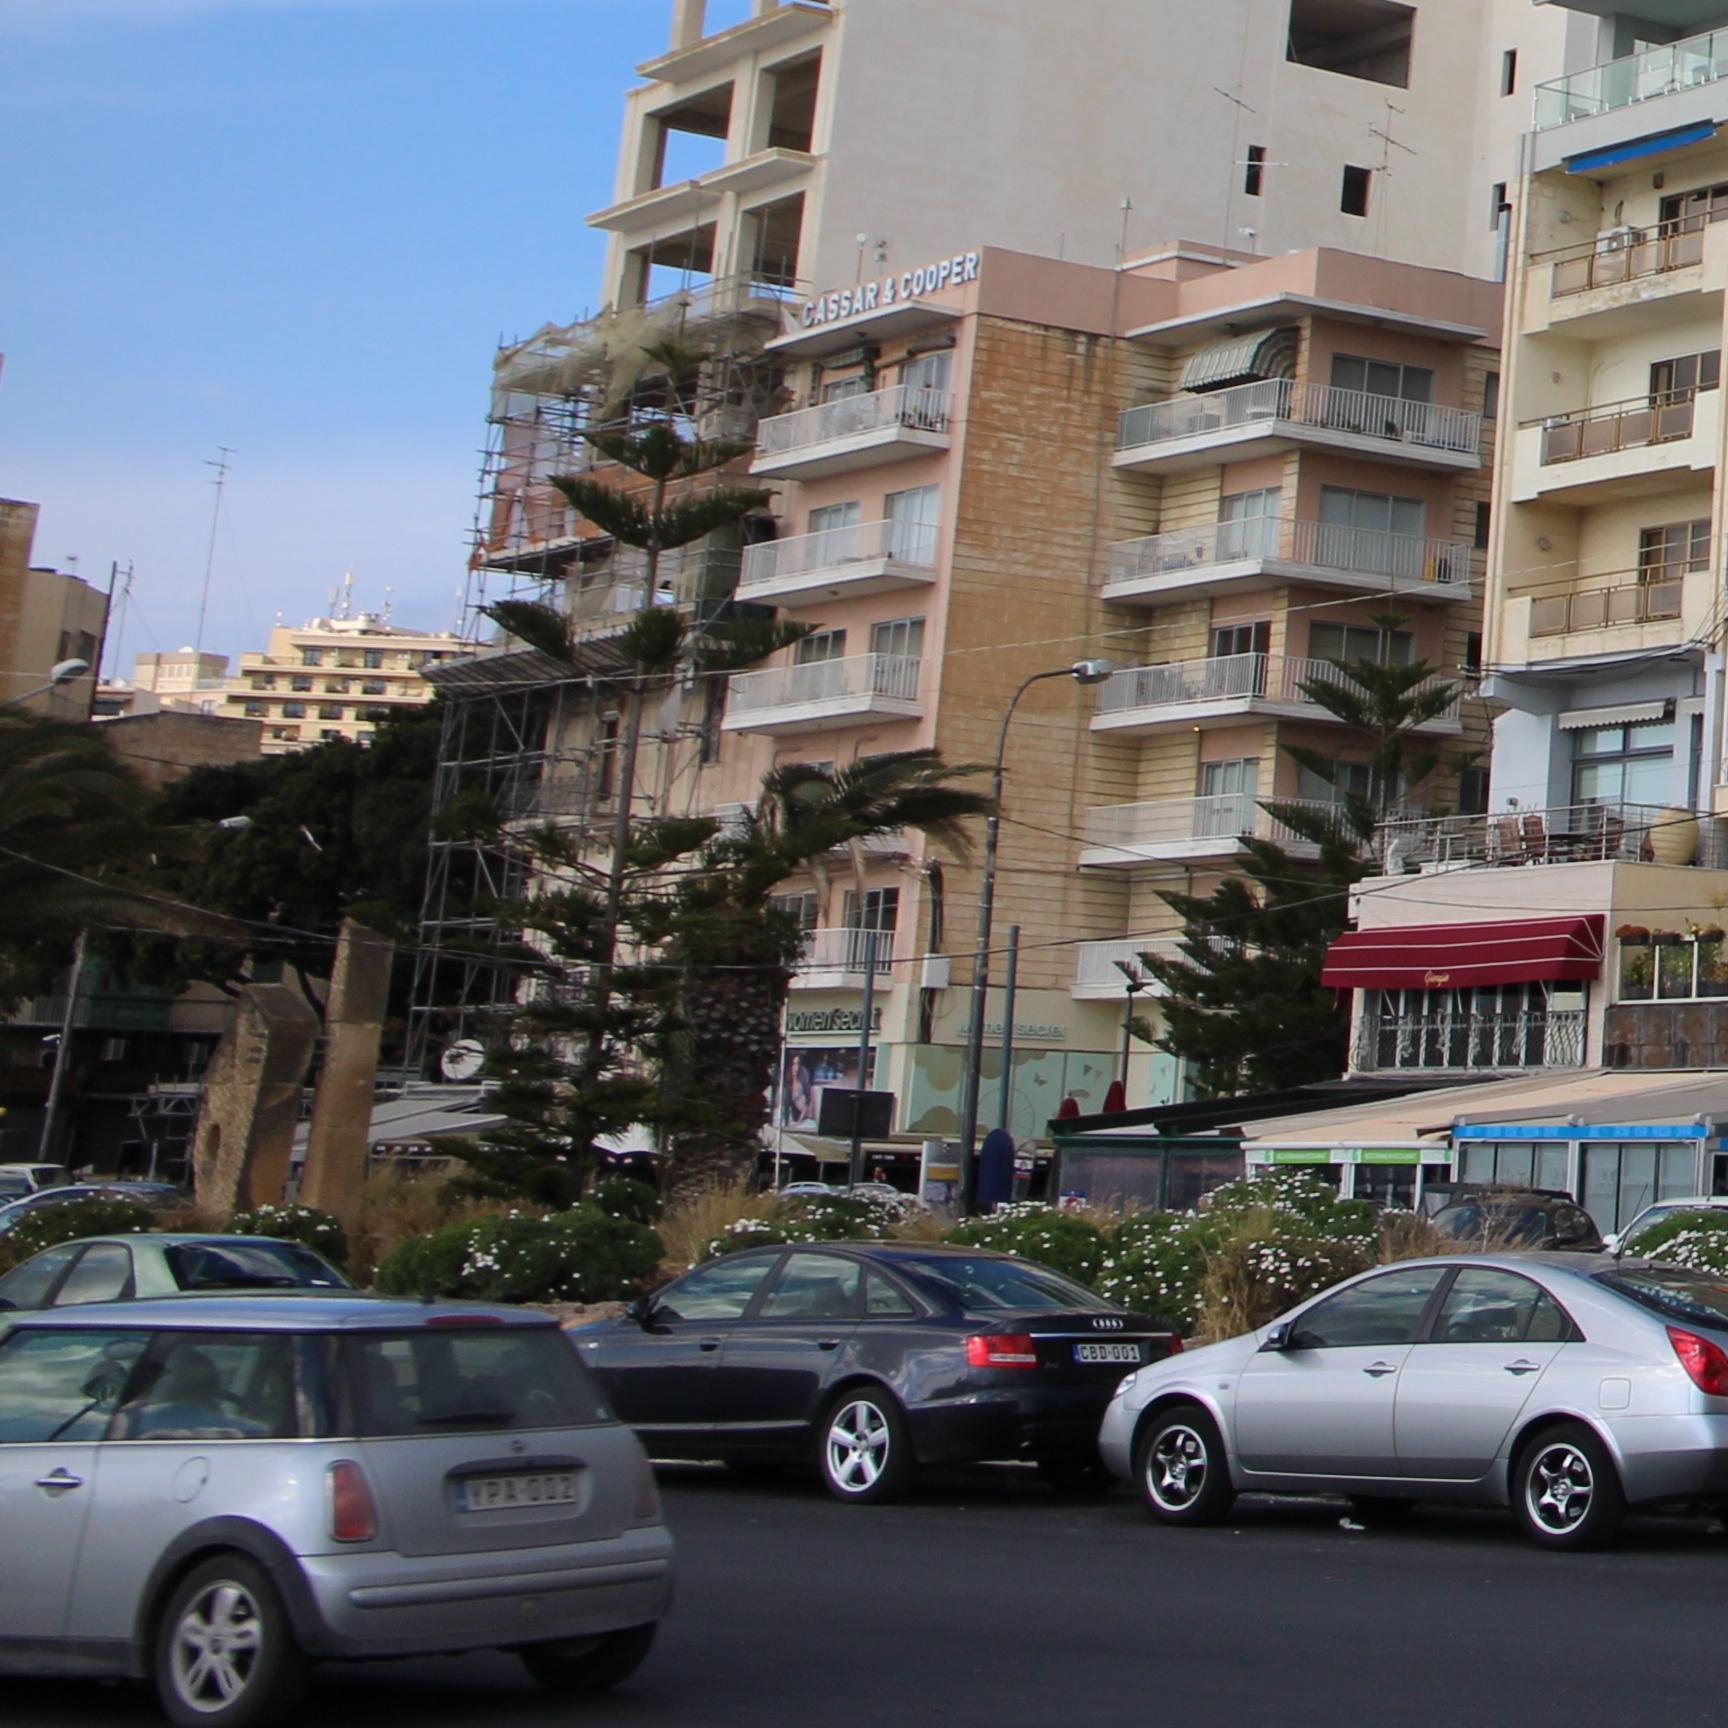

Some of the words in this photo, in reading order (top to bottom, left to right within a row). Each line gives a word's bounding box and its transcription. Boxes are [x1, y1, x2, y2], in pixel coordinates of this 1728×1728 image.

[802, 282, 879, 327] CASSAR
[882, 278, 896, 304] &
[900, 252, 980, 299] COOPER
